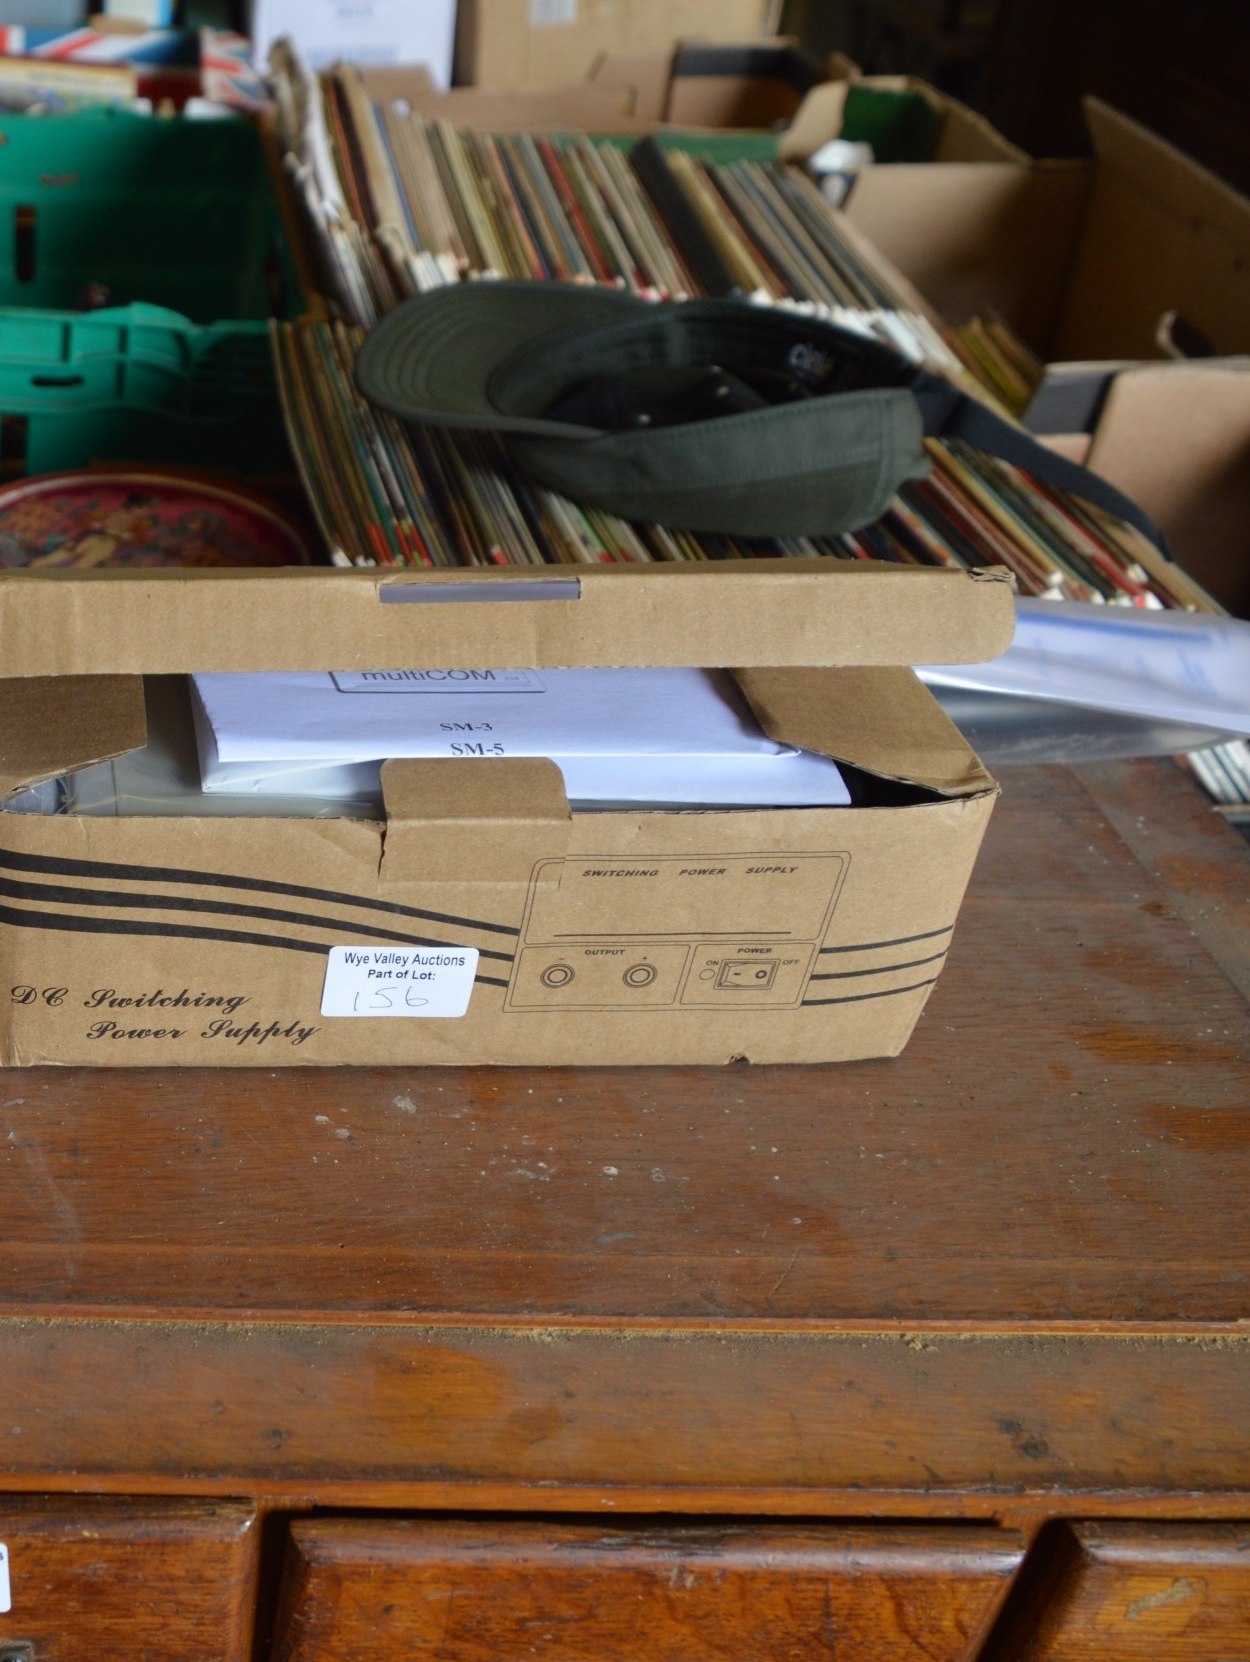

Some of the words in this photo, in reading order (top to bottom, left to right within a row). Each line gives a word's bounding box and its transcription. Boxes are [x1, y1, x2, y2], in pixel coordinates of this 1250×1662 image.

[440, 722, 493, 732] SM-3
[450, 743, 505, 756] SM-5
[582, 869, 660, 878] SWITCHING
[679, 867, 726, 876] POWER
[745, 866, 798, 874] SUPPLY
[344, 952, 370, 967] Wye
[374, 953, 409, 967] Valley
[411, 954, 465, 966] Auctions
[368, 969, 392, 979] Part
[396, 970, 409, 979] of
[412, 971, 436, 980] Lot:
[11, 985, 69, 1007] DC
[84, 988, 252, 1014] Switching
[353, 985, 429, 1012] 156
[86, 1021, 189, 1040] Power
[200, 1019, 322, 1045] Supply
